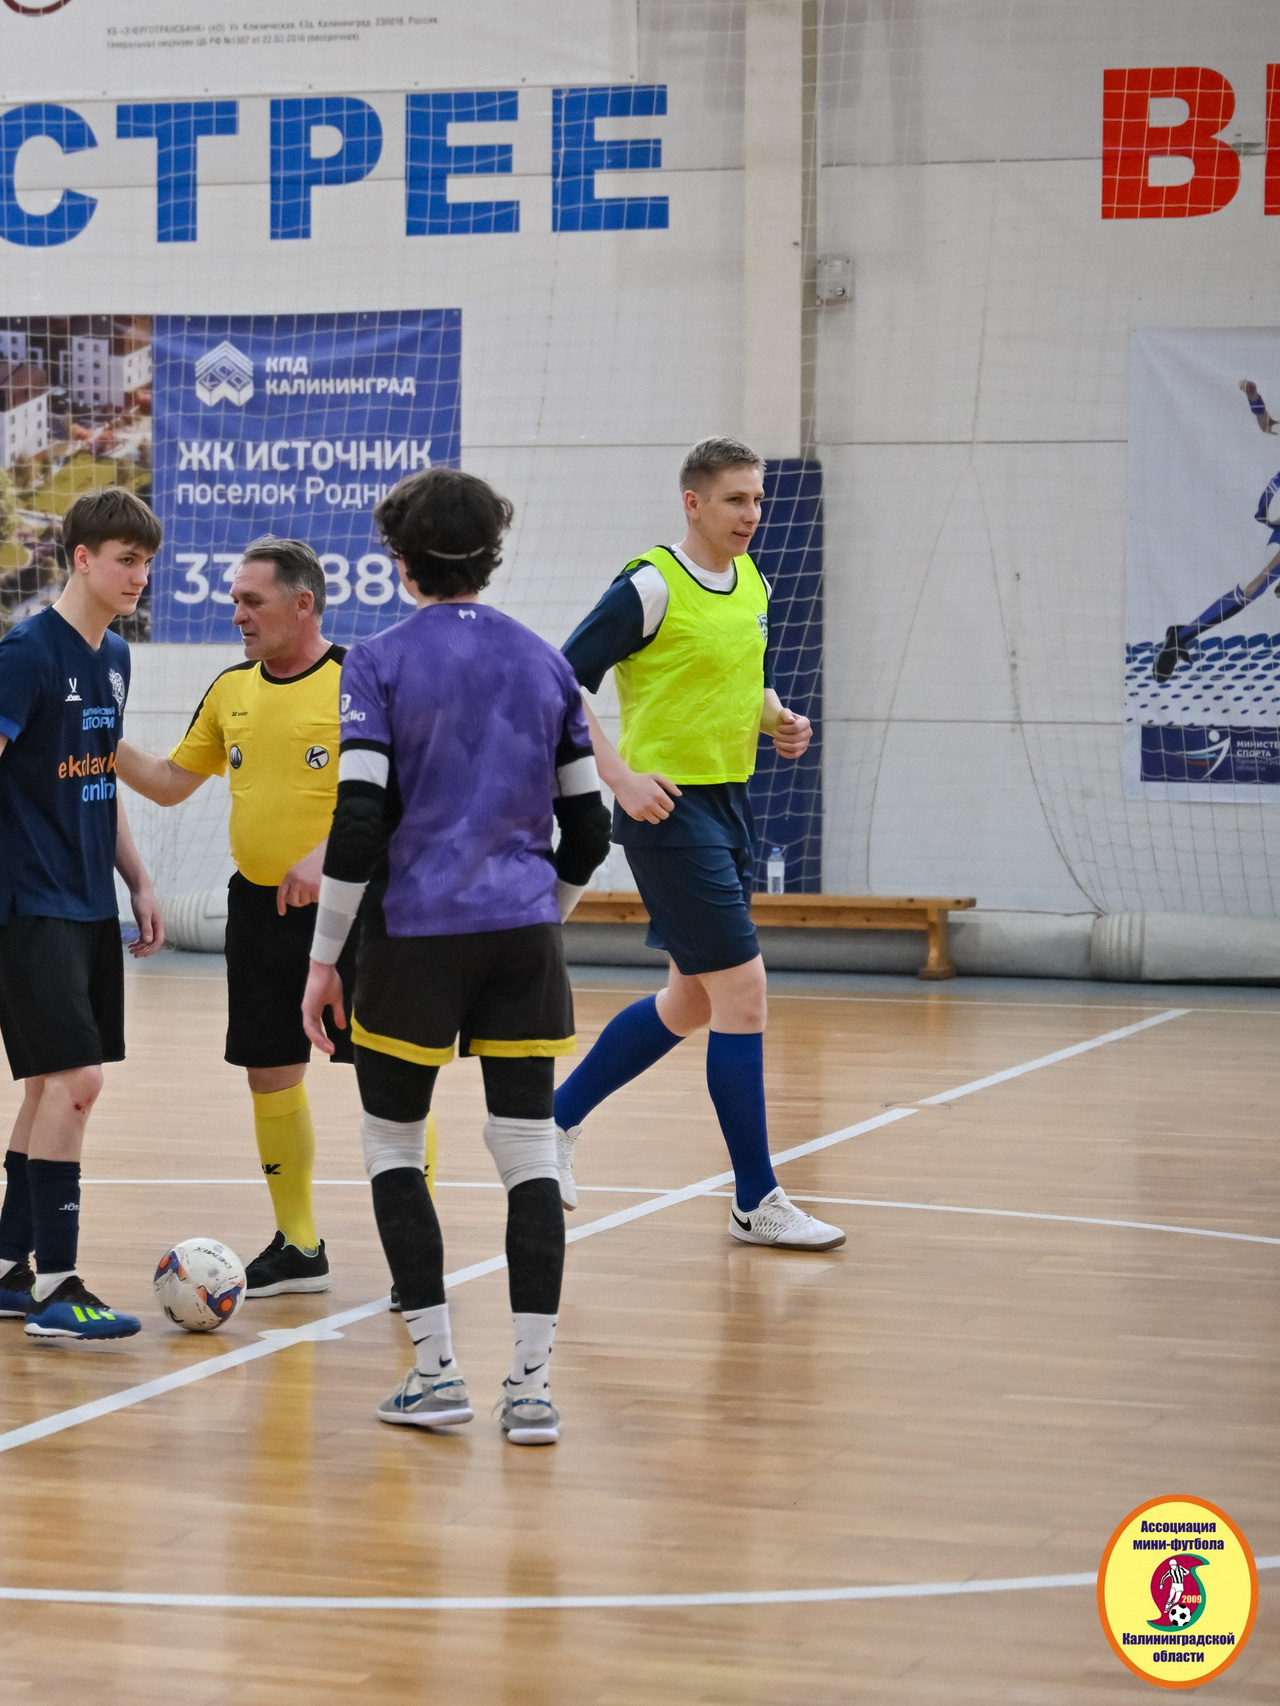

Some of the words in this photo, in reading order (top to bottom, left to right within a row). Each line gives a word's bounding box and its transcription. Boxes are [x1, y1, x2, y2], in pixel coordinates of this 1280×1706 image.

[265, 356, 308, 375] КПД
[265, 377, 416, 396] КАЛИНИНГРАД
[179, 440, 235, 471] ЖК
[246, 440, 432, 471] ИСТОЧНИК
[177, 483, 296, 505] поселок
[306, 477, 399, 509] Родни
